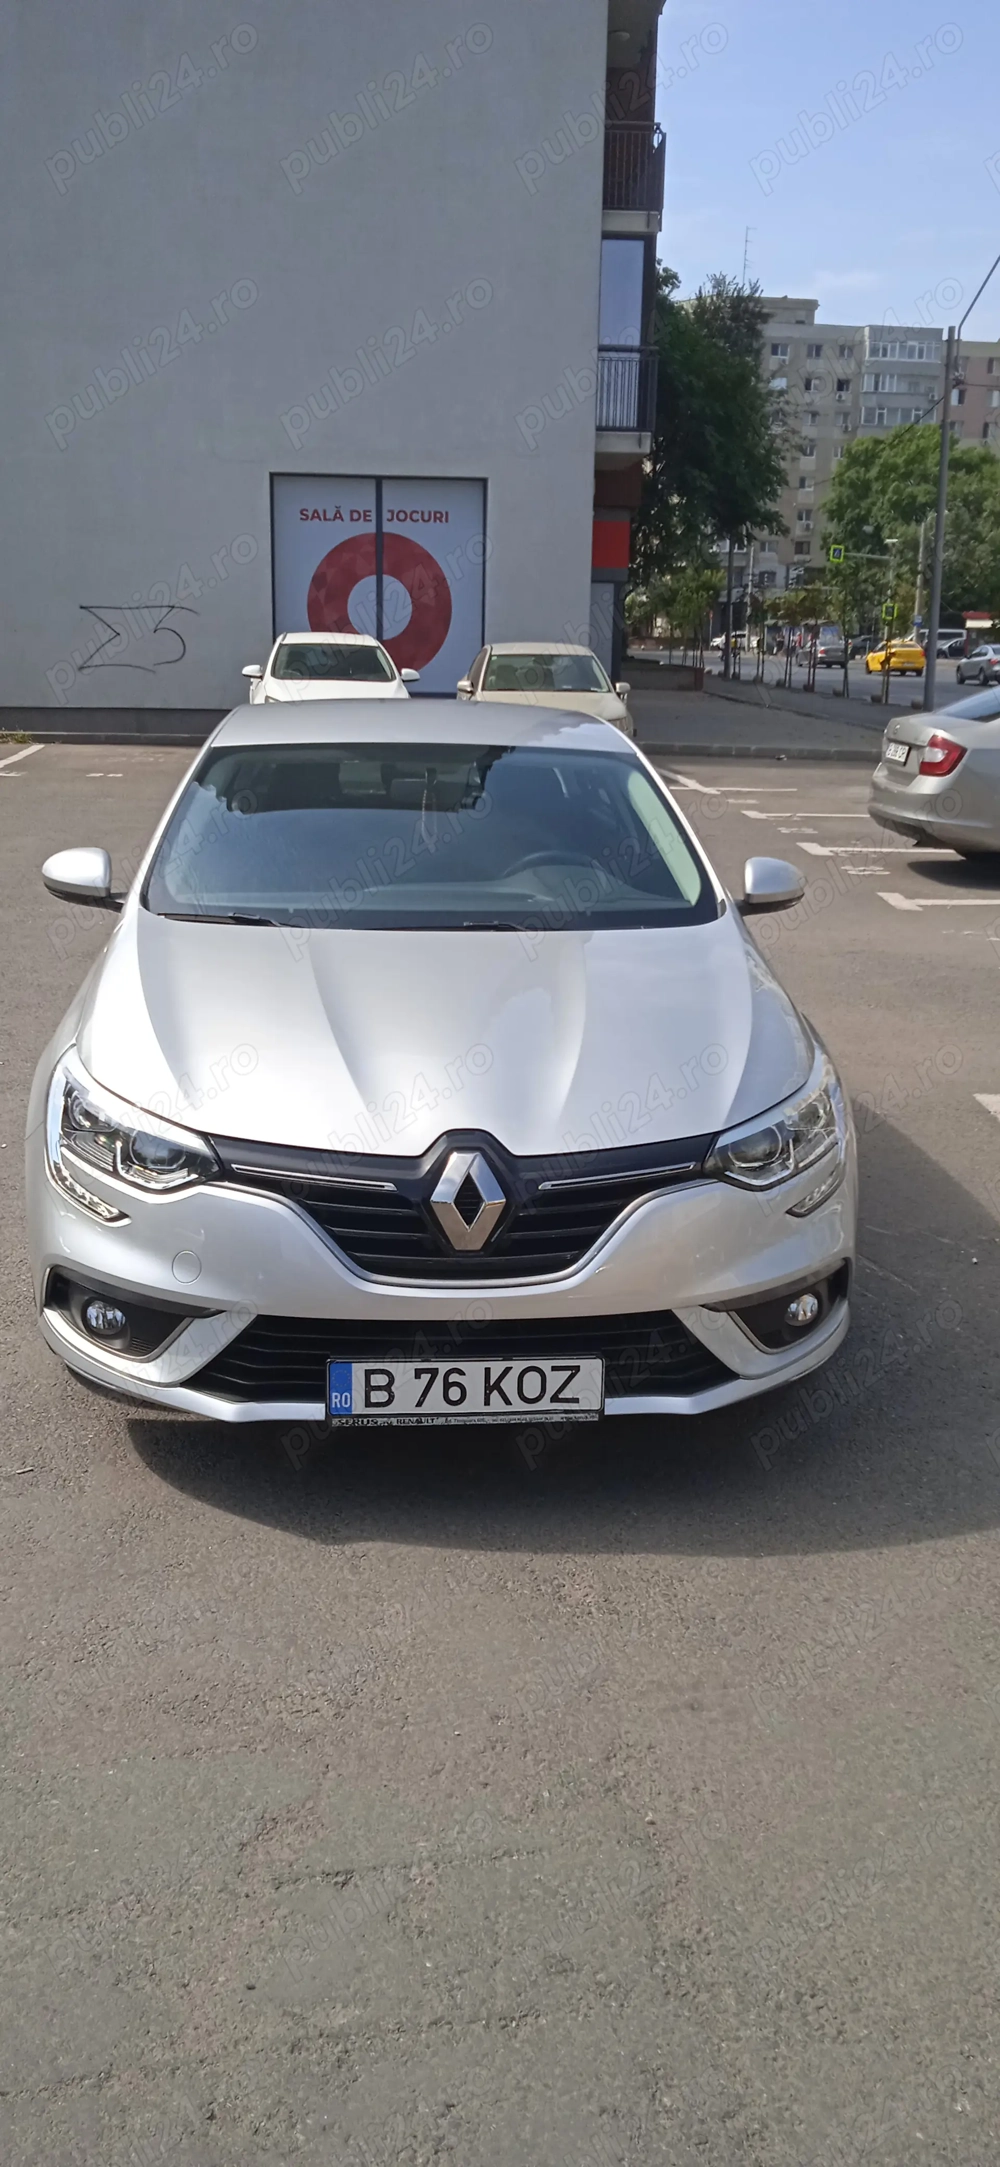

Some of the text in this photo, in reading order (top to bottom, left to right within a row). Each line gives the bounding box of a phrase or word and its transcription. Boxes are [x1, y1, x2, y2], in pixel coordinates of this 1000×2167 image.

[300, 505, 449, 523] SALĂ DE JOCURI
[364, 1365, 581, 1408] B 76 KOZ
[332, 1392, 350, 1408] RO
[396, 1417, 436, 1426] RENAULT
